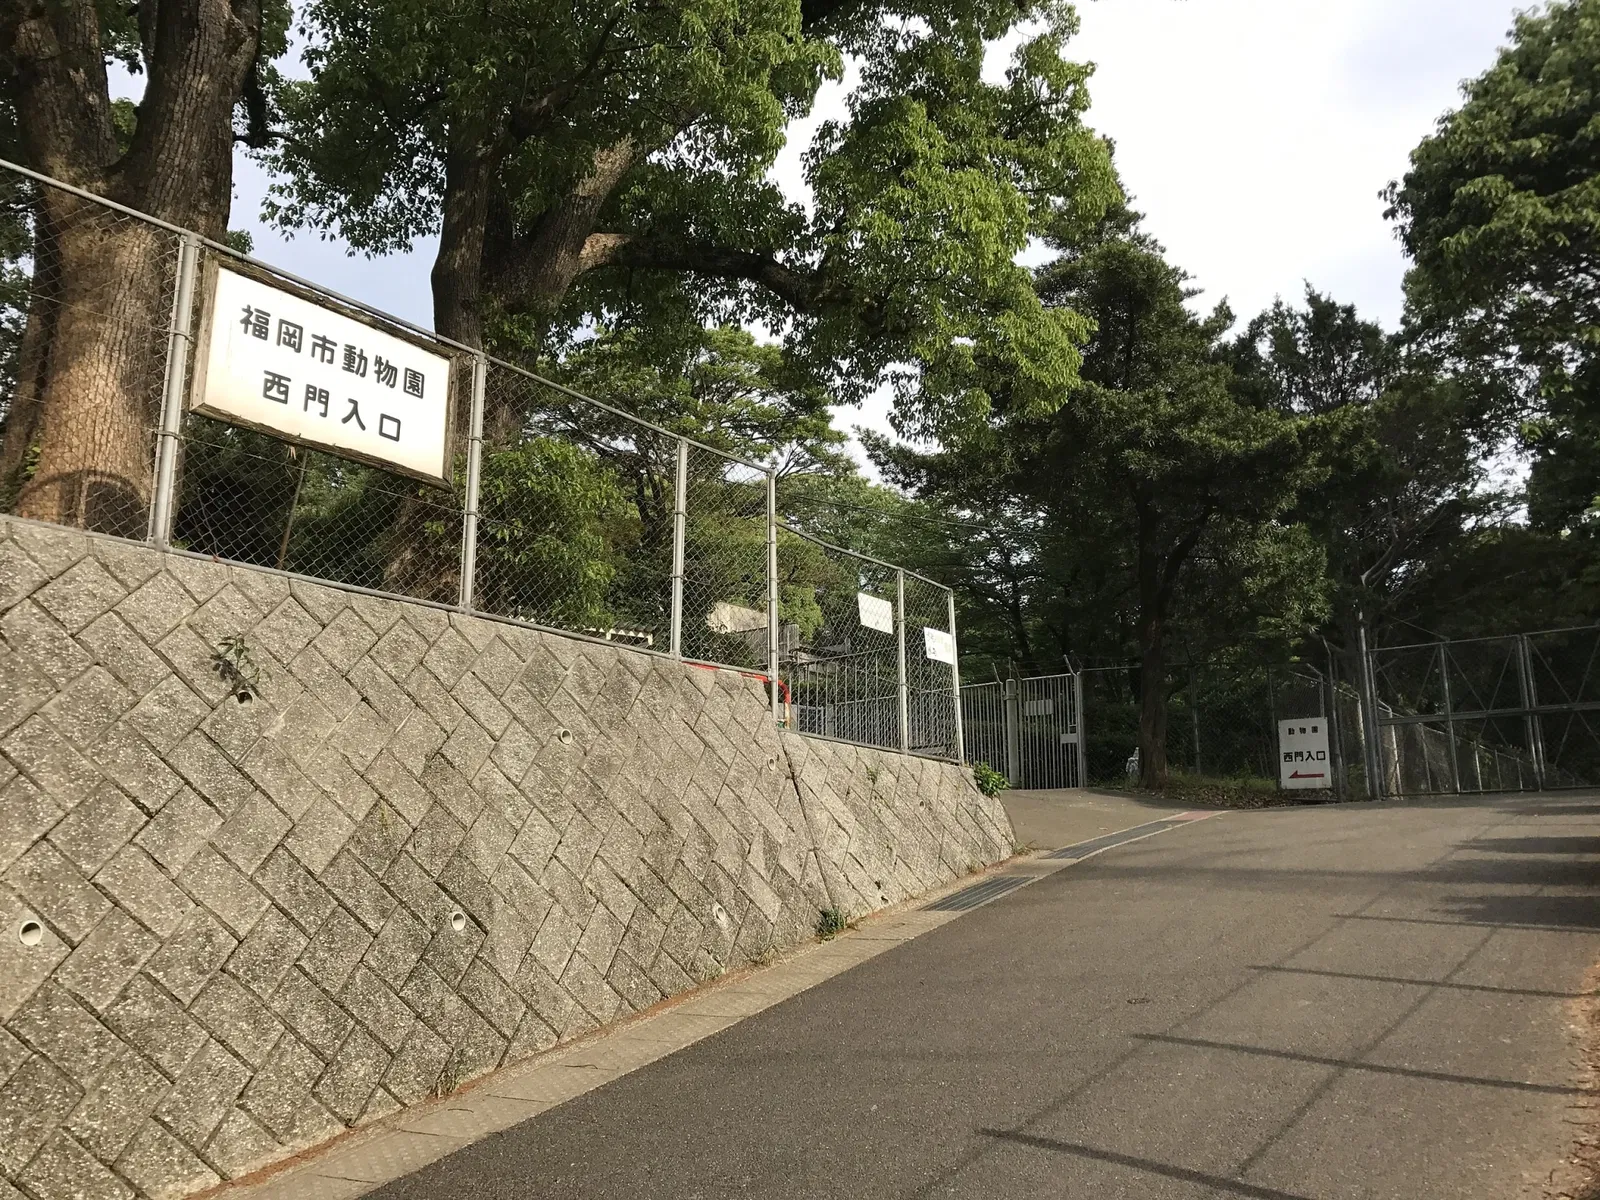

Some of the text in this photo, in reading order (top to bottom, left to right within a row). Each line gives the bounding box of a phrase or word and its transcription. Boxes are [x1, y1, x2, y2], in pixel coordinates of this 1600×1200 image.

[240, 305, 425, 399] 福岡市動物園
[263, 370, 402, 442] 西門入口
[1288, 726, 1318, 735] 動物園
[1283, 751, 1326, 762] 西門入口
